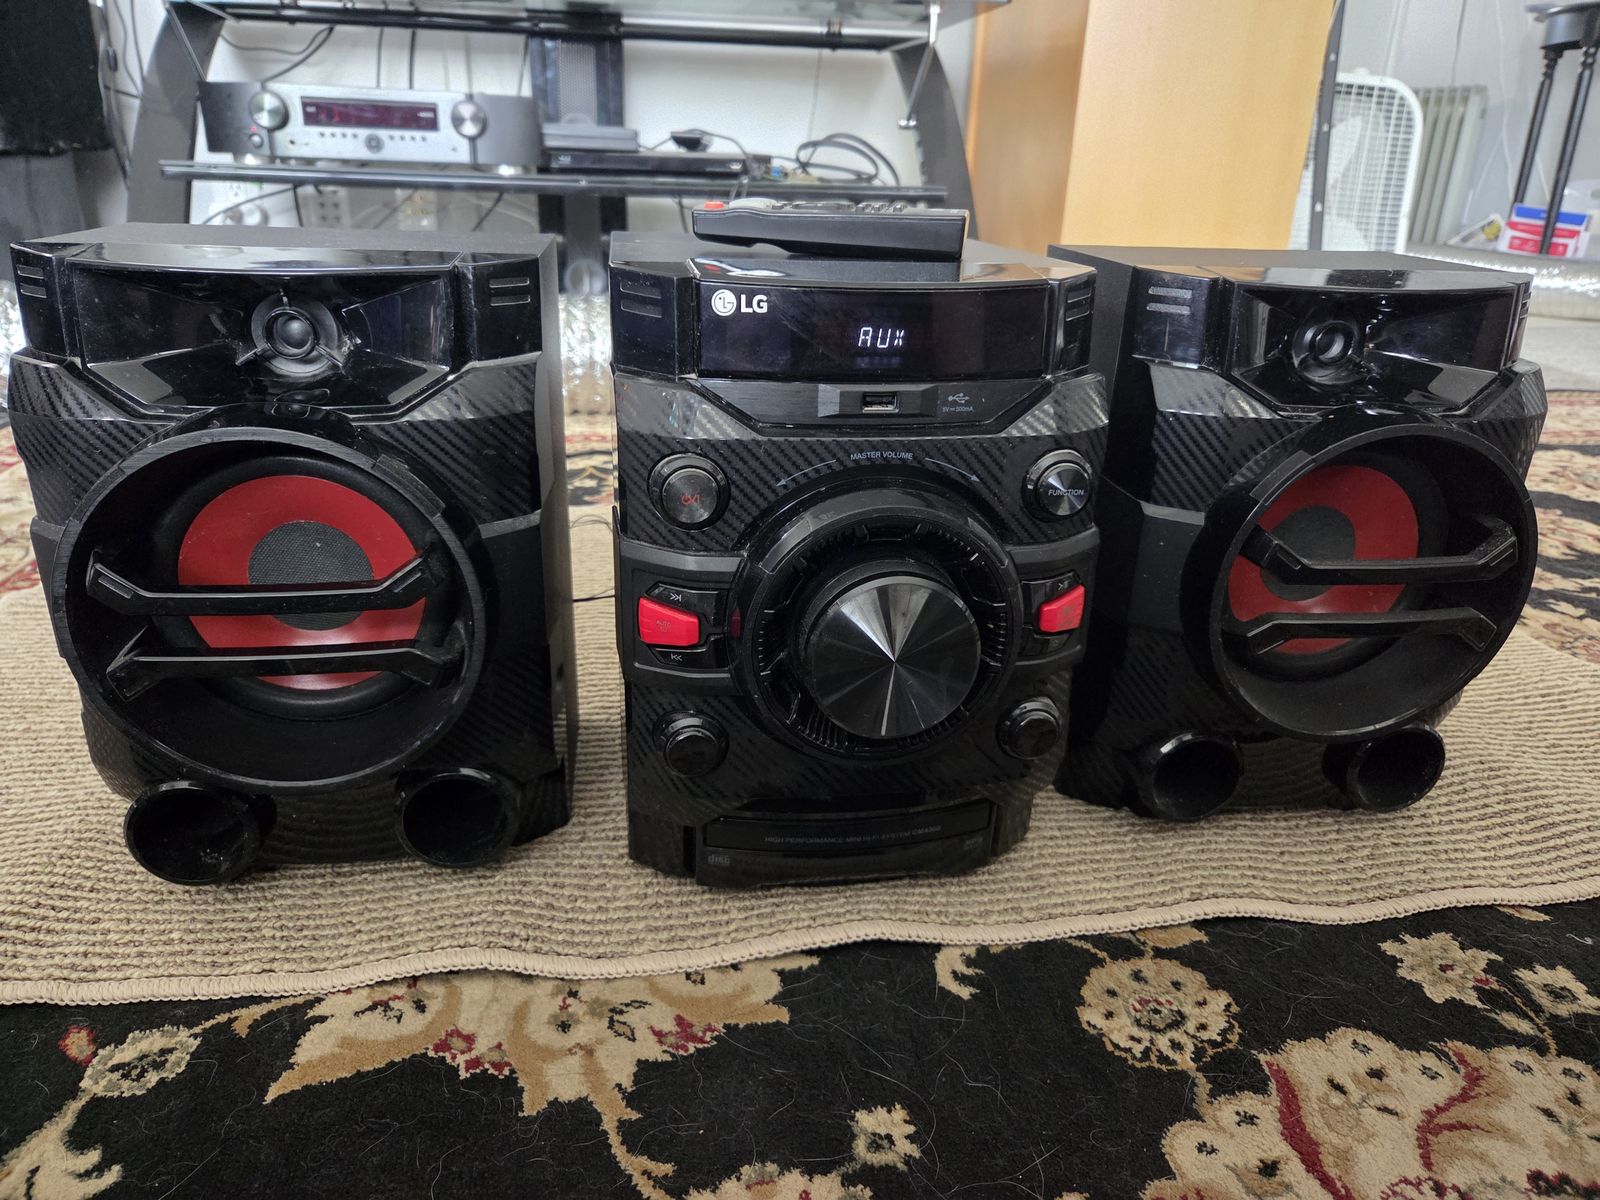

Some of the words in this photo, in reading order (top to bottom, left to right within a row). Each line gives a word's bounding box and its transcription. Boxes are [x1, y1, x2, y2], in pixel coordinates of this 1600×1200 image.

[740, 294, 768, 314] LG
[858, 327, 905, 348] AUX
[850, 451, 881, 461] MASTER
[882, 451, 914, 460] VOLUME
[1048, 488, 1085, 496] FUNCTION
